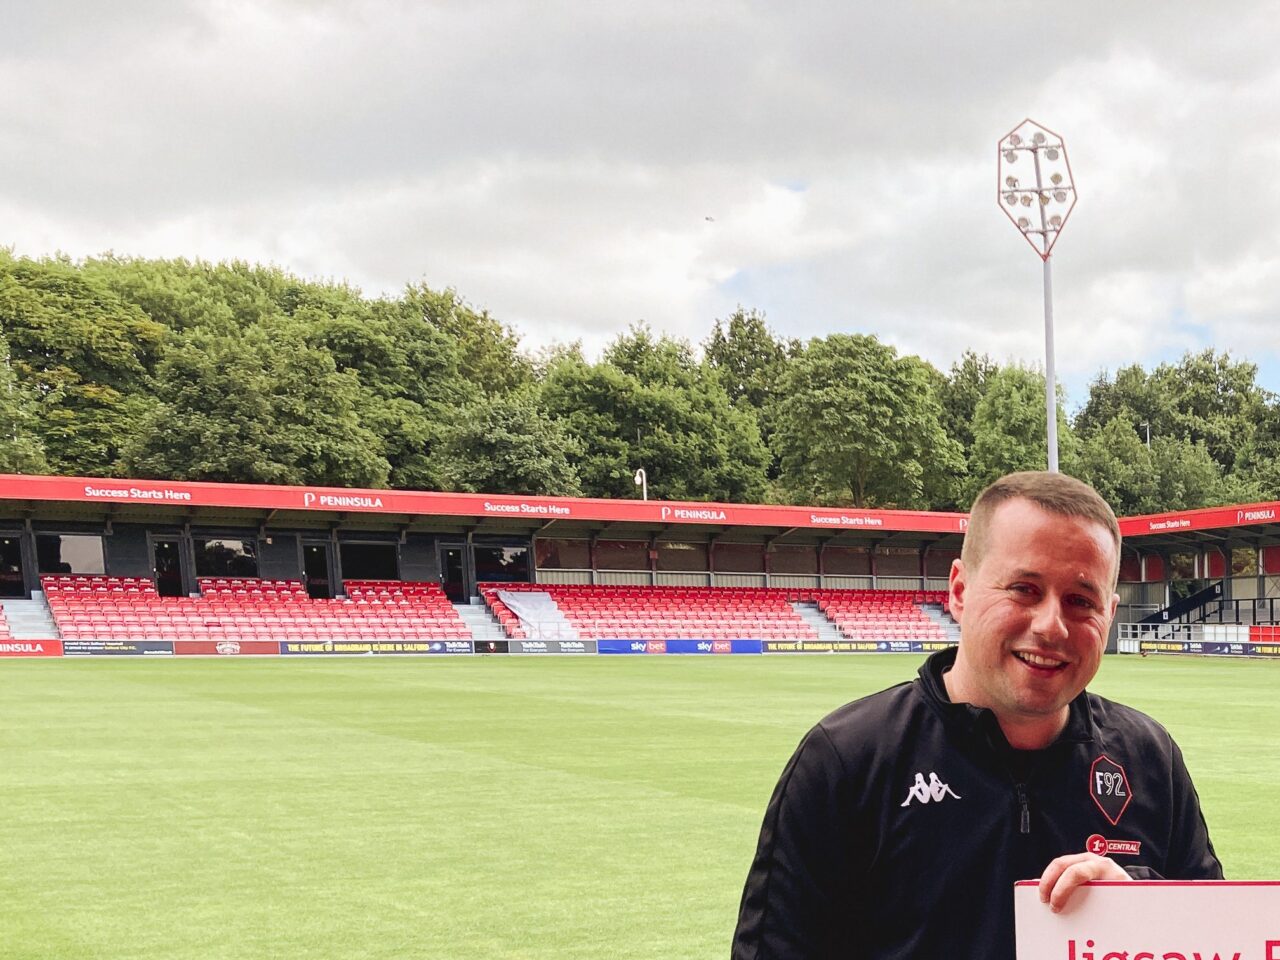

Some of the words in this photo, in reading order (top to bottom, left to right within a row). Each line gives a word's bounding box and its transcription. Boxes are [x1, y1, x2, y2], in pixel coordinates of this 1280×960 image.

[84, 486, 129, 498] Success
[130, 488, 164, 500] Starts
[165, 490, 191, 500] Here
[320, 496, 383, 507] PENINSULA
[484, 502, 519, 512] Success
[521, 504, 548, 514] Starts
[549, 506, 570, 515] Here
[674, 509, 726, 520] PENINSULA
[1244, 510, 1275, 520] PENINSULA
[811, 515, 840, 524] Success
[841, 516, 863, 525] Starts
[864, 518, 882, 526] Here
[0, 643, 44, 653] INSULA
[630, 642, 646, 652] sky
[649, 642, 664, 650] bet
[697, 642, 712, 652] sky
[715, 642, 729, 650] bet
[1095, 771, 1126, 796] F92
[1108, 843, 1138, 851] CENTRAL
